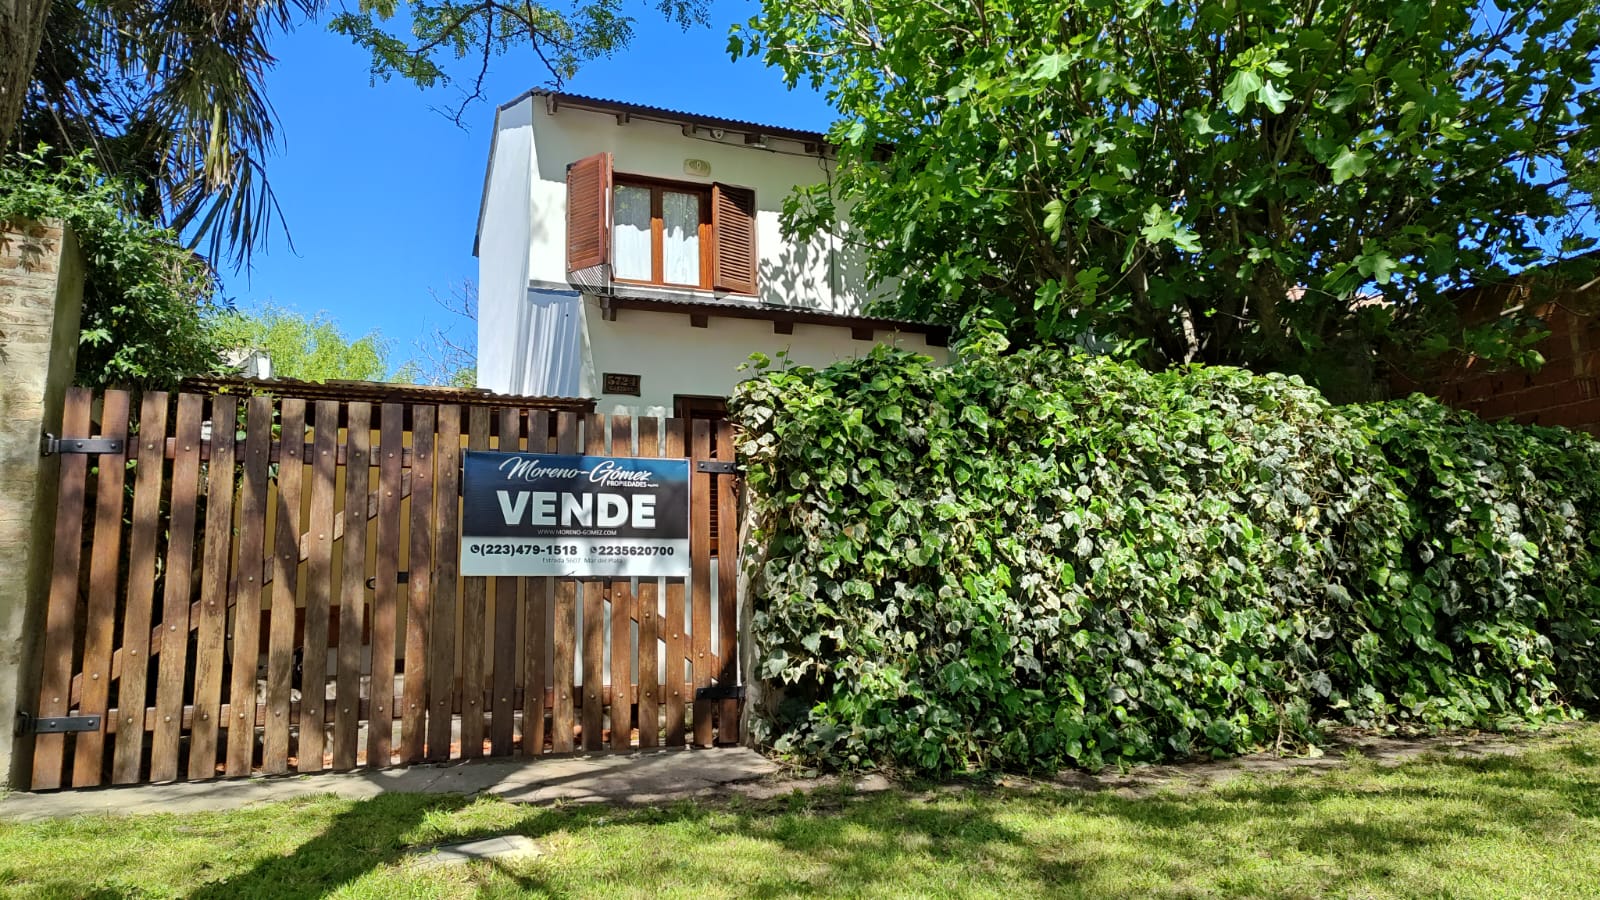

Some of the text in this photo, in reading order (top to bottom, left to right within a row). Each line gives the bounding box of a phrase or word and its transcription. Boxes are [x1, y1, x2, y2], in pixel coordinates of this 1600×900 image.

[606, 480, 647, 488] PROPIEDADES
[496, 490, 657, 529] VENDE
[480, 544, 577, 557] (223)479-1518
[598, 545, 674, 556] 2235620700
